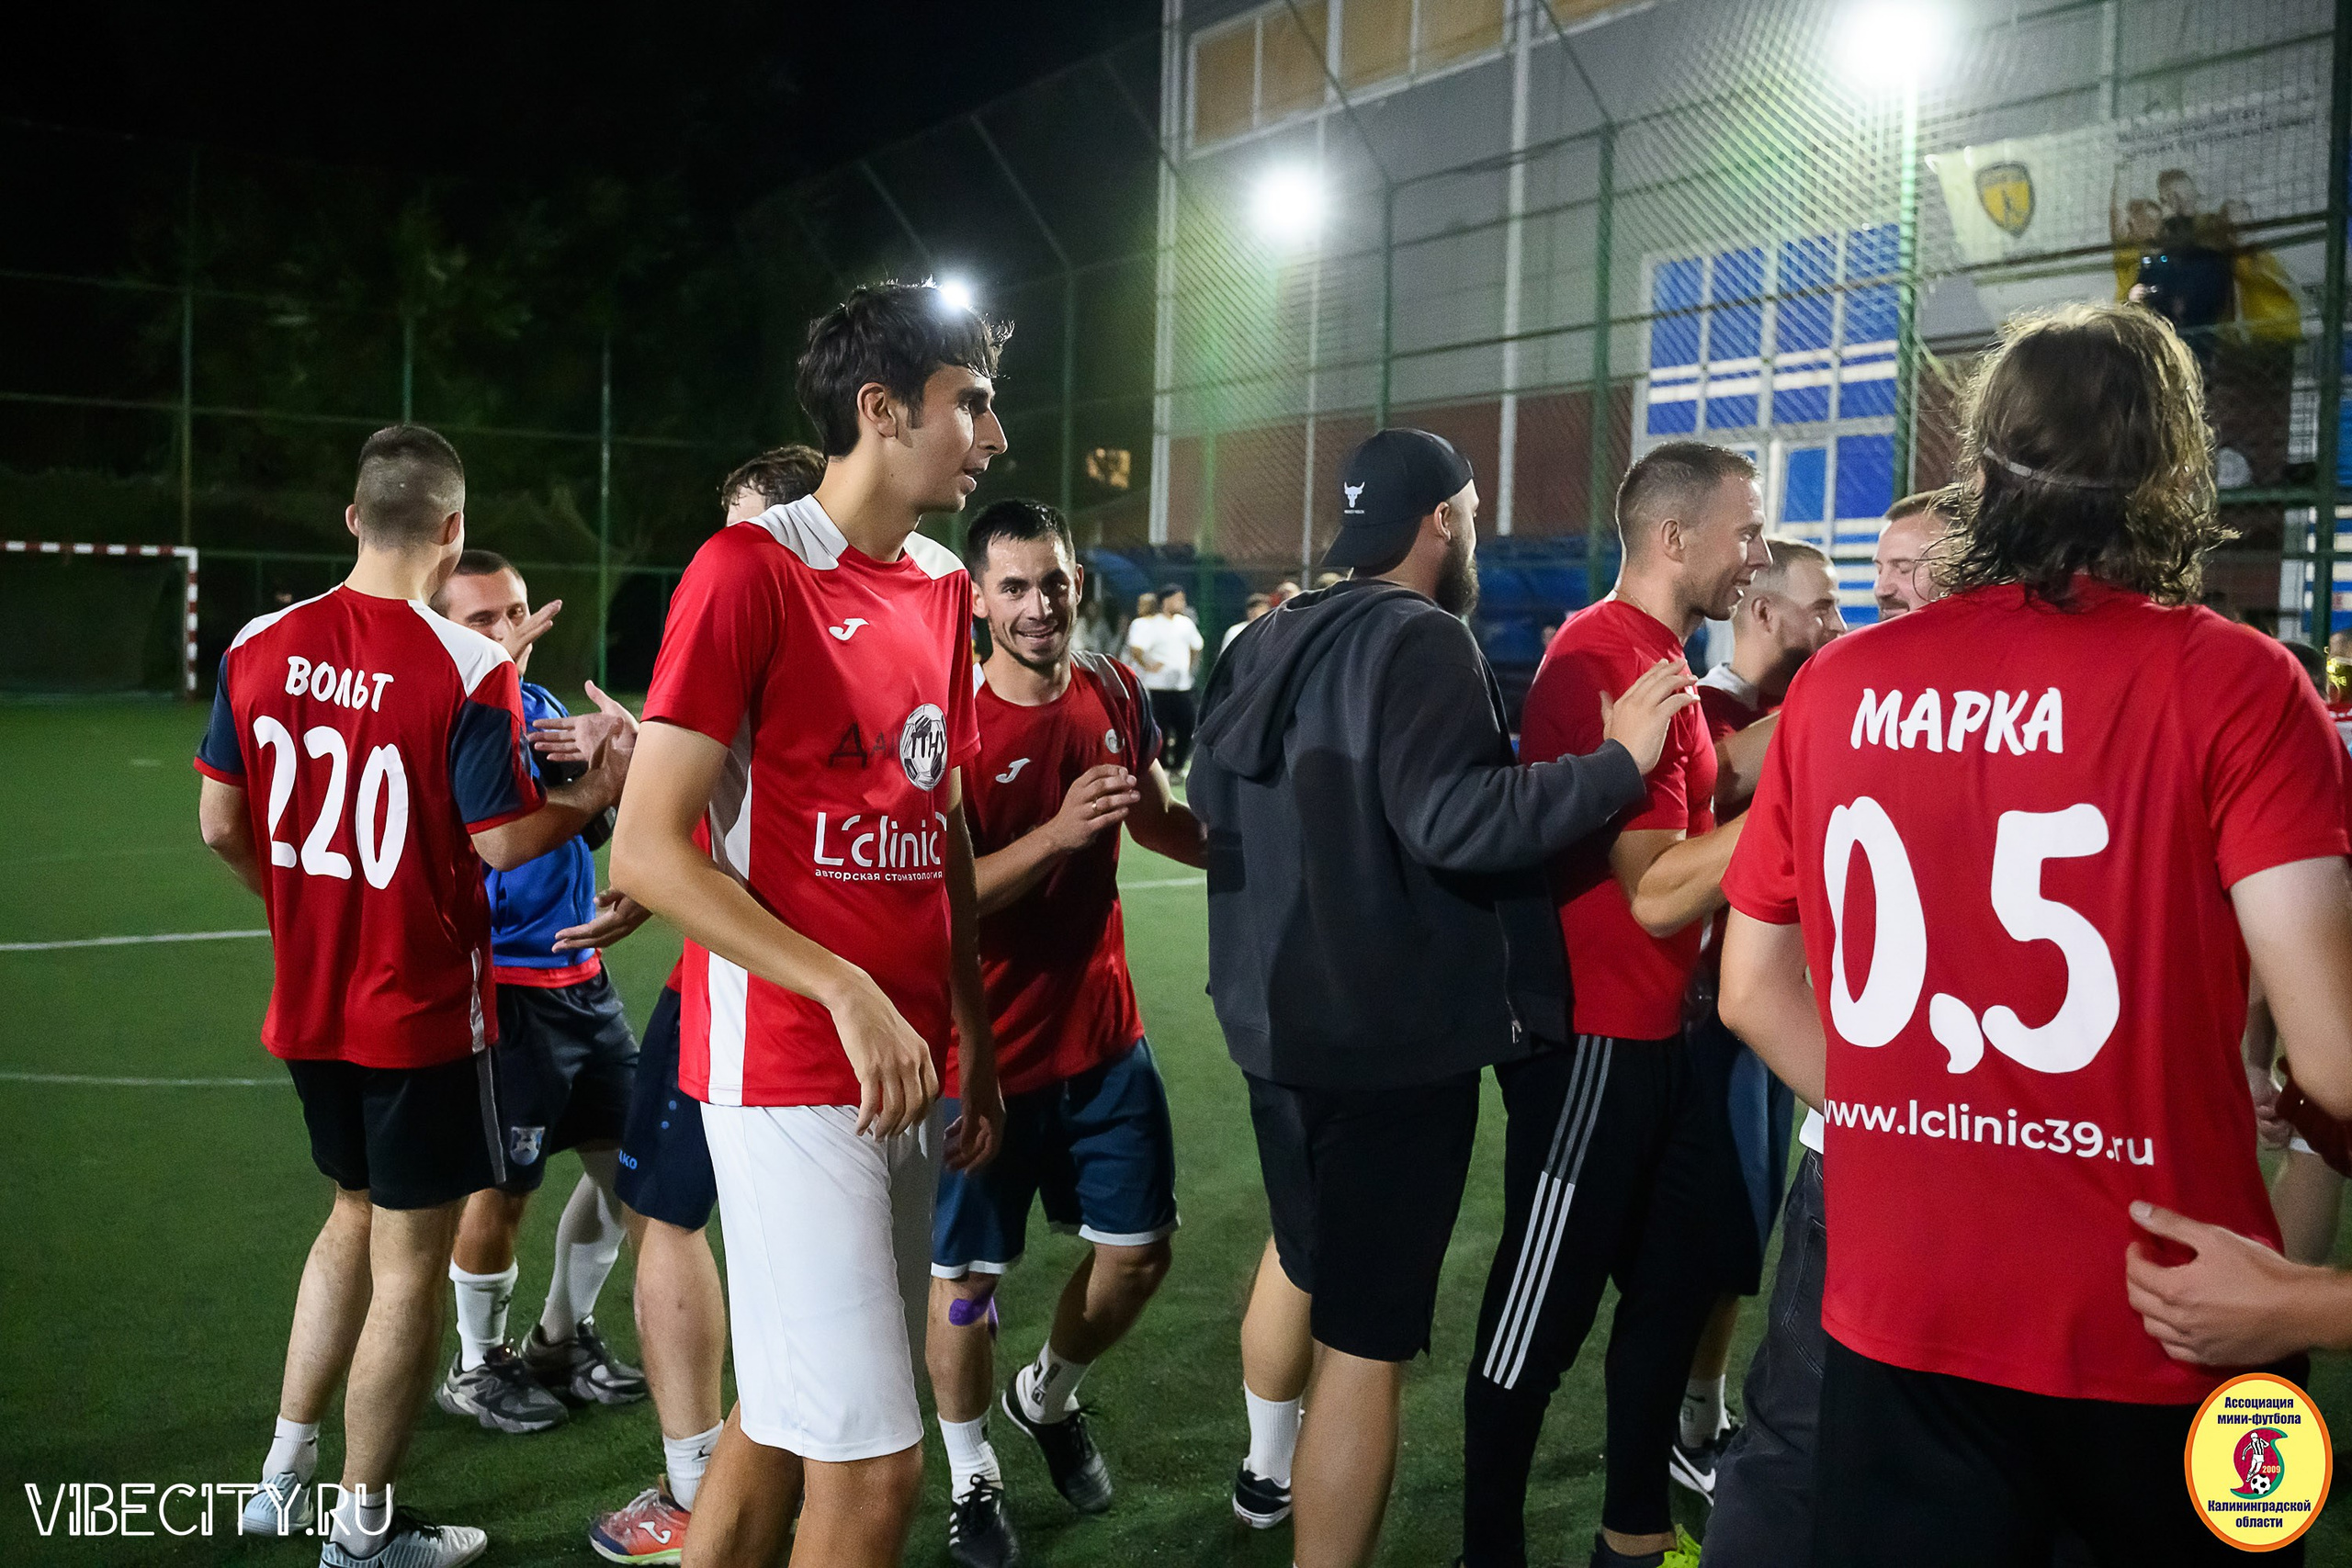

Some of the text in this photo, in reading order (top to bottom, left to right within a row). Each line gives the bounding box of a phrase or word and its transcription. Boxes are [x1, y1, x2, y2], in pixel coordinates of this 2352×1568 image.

[285, 655, 394, 713] ВОЛЬТ
[1850, 687, 2064, 756] МАРКА
[253, 715, 409, 890] 220
[815, 869, 943, 882] авторская стоматология
[1823, 795, 2120, 1074] 0,5
